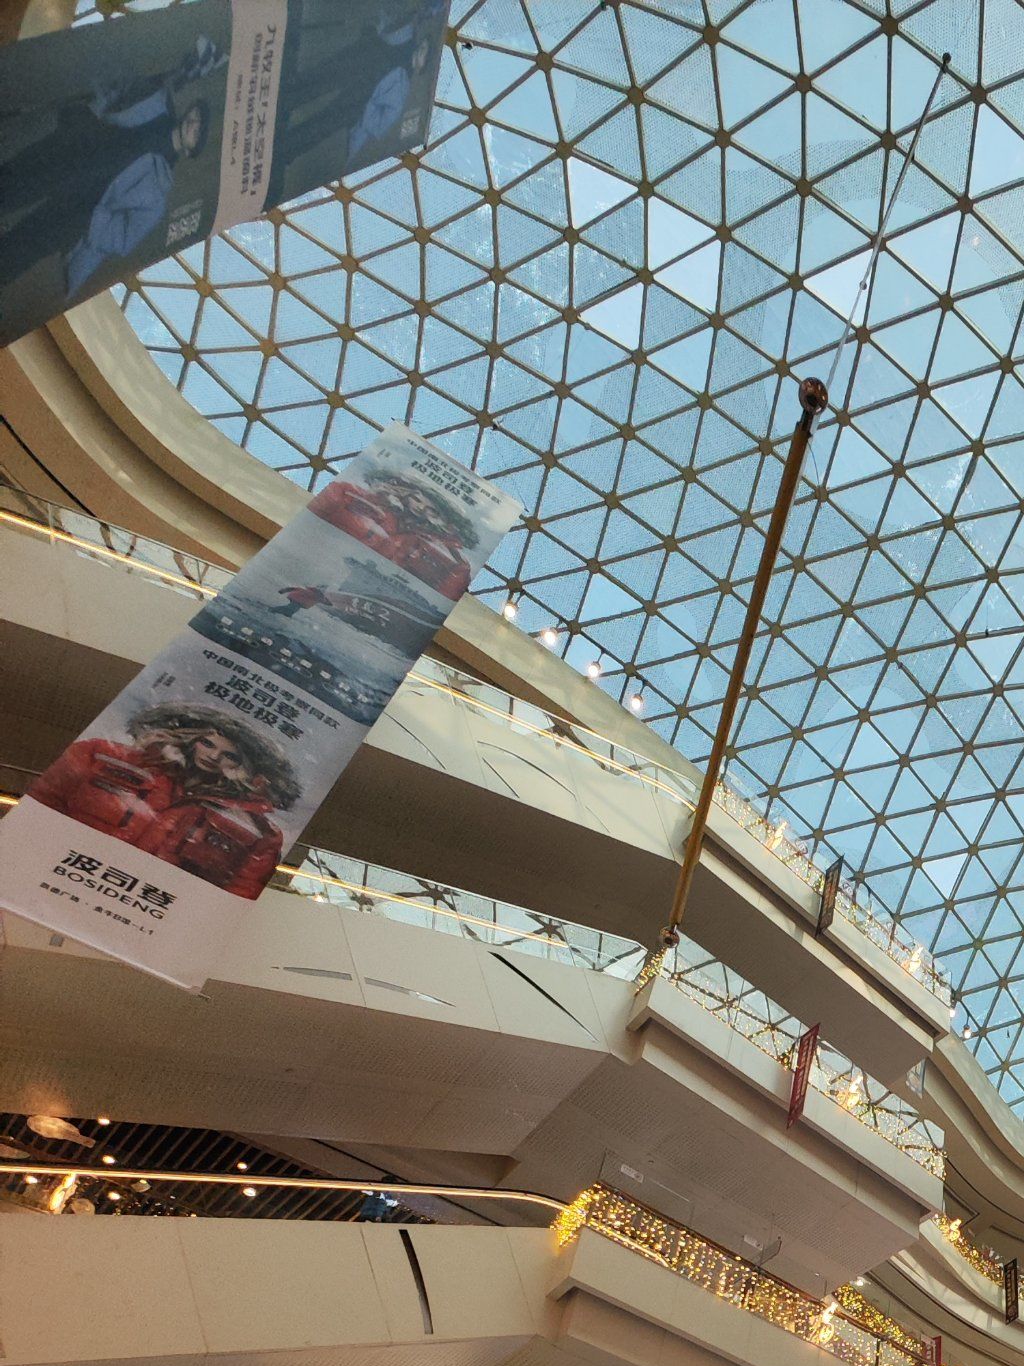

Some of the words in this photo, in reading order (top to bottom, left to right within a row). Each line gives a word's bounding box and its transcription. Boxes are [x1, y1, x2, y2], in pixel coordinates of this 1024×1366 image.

[225, 674, 301, 722] 波司登
[53, 866, 164, 920] BOSIDENG
[61, 850, 177, 910] 波司登
